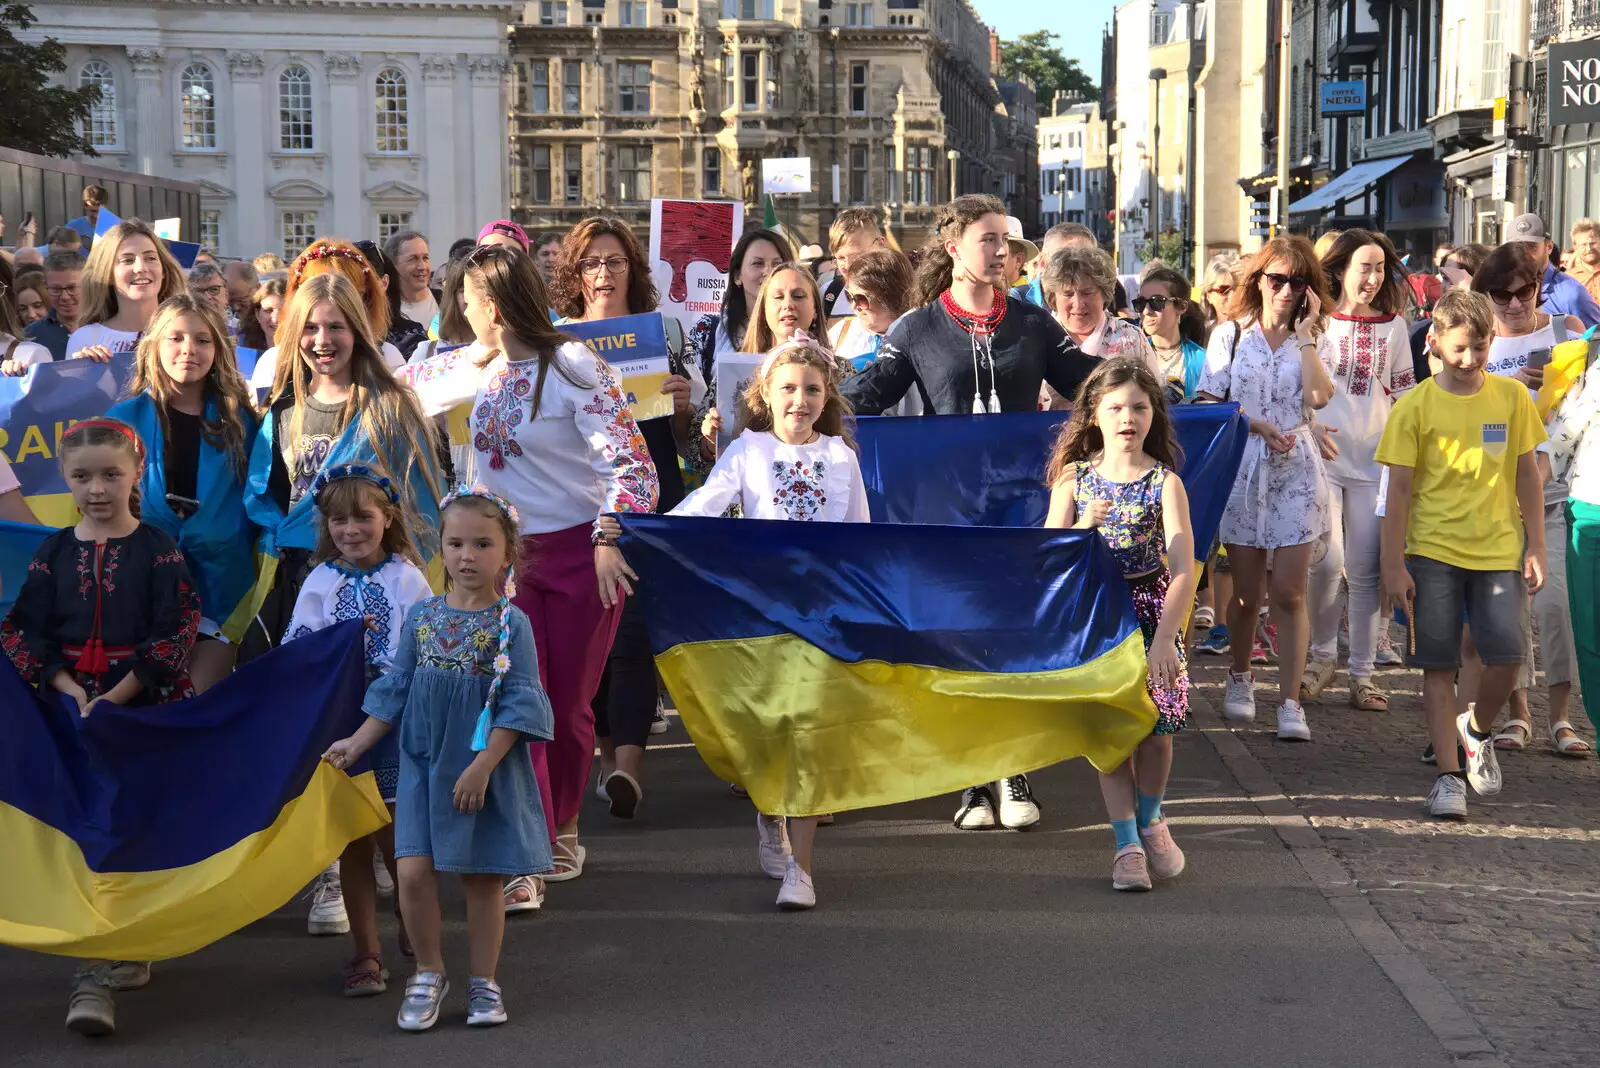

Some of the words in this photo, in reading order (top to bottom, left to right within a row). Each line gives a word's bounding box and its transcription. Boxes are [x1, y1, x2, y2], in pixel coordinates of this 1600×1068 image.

[1326, 96, 1361, 105] NERO
[697, 278, 726, 289] RUSSIA
[712, 290, 721, 301] IS
